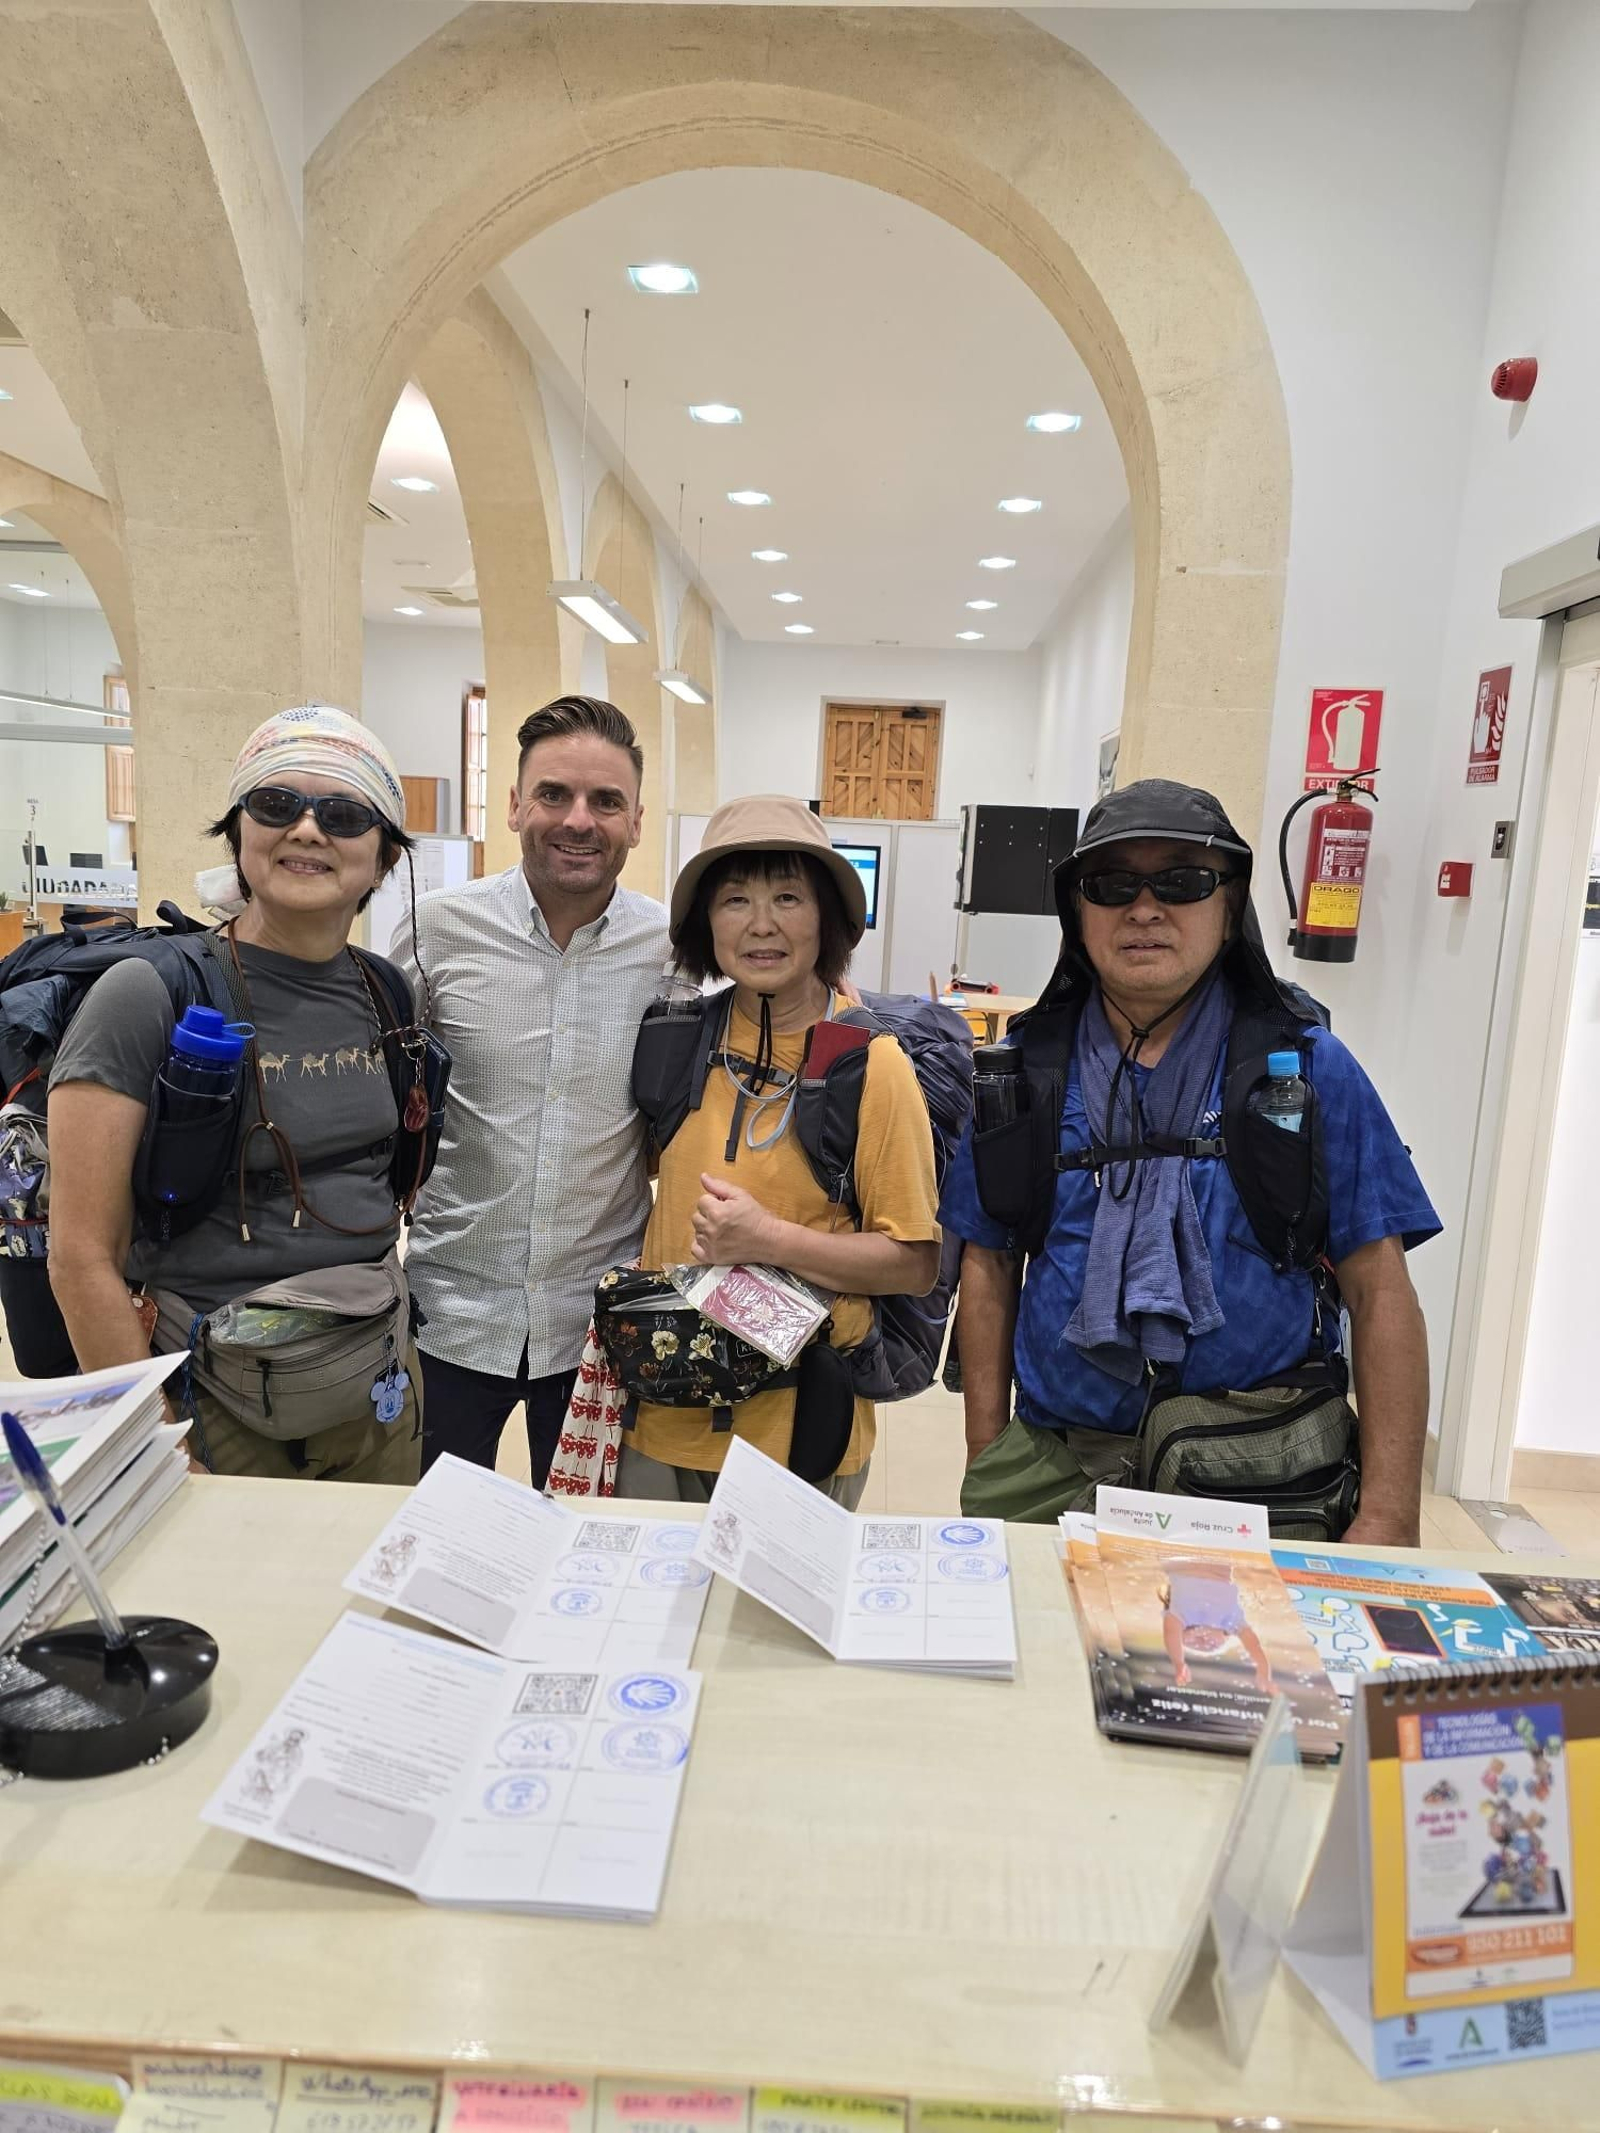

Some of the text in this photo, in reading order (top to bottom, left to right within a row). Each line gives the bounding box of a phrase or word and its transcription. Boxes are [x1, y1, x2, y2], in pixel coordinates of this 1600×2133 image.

[1190, 1520, 1234, 1534] Cruz Roja
[1192, 1704, 1266, 1723] infancia
